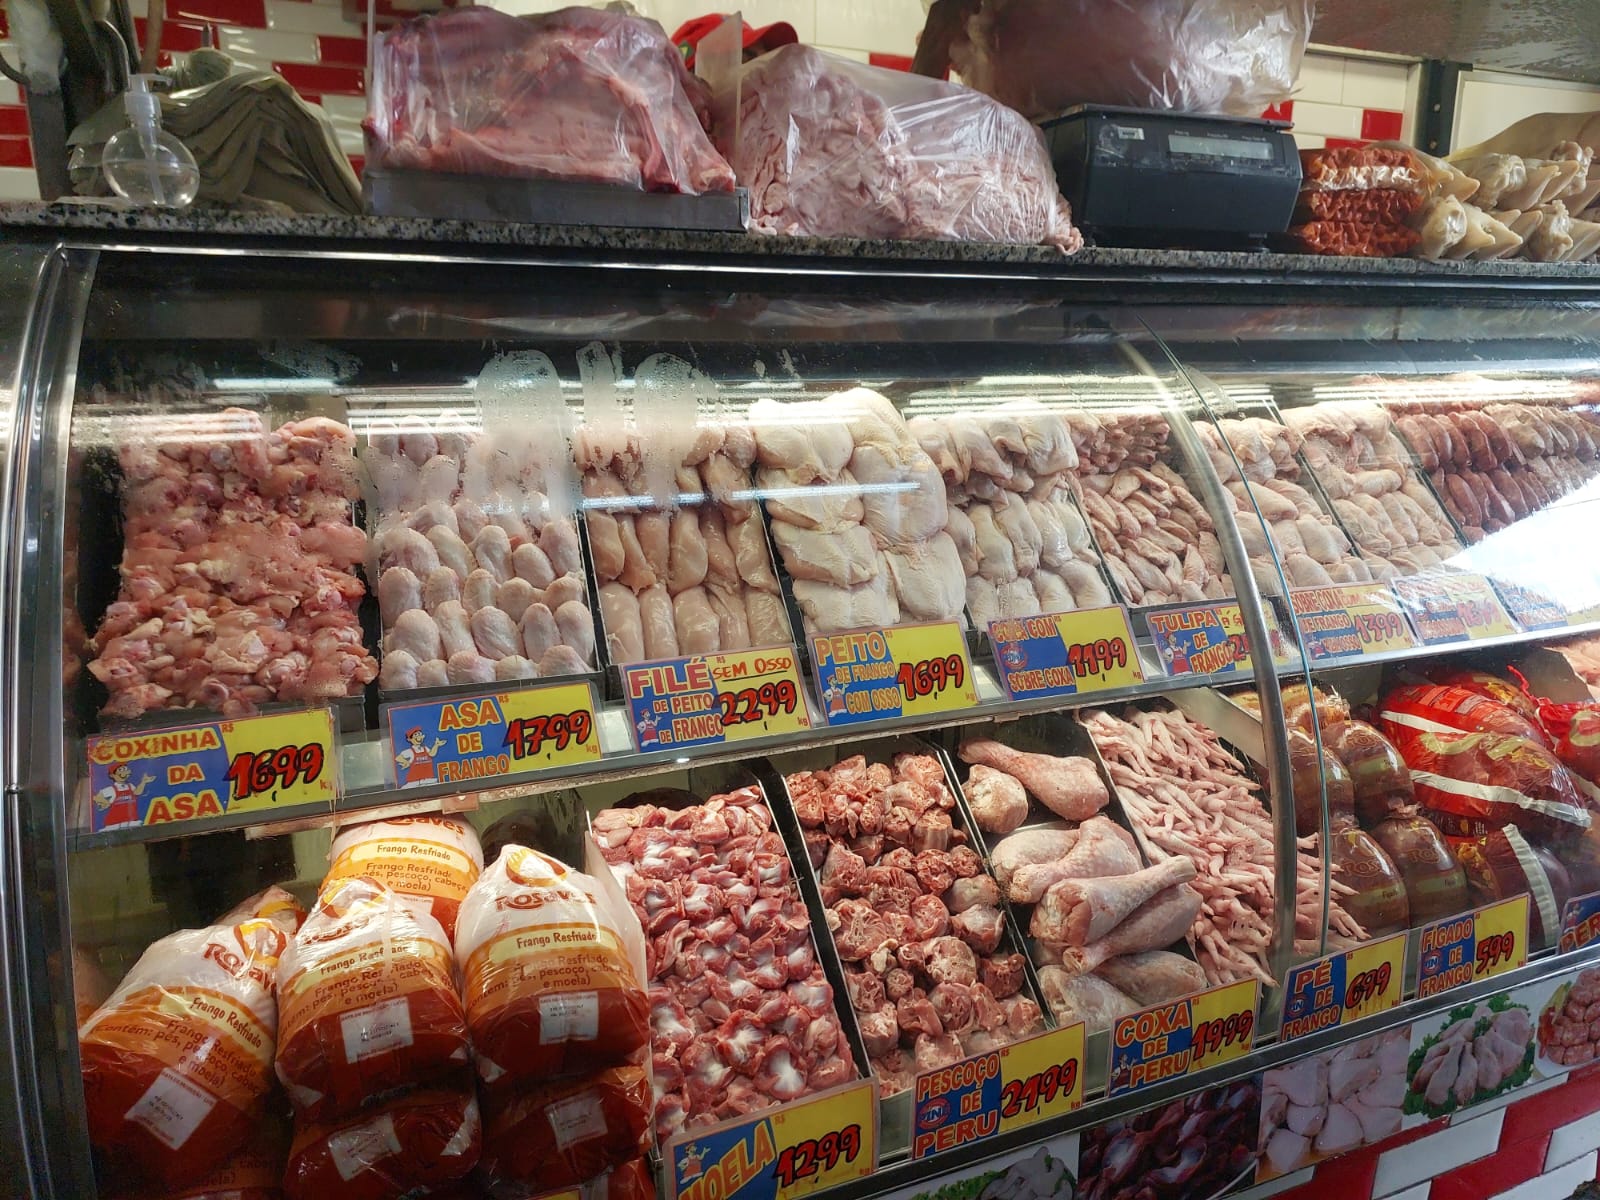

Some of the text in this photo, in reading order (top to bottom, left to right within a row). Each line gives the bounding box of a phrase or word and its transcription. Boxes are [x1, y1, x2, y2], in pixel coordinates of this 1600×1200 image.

[1318, 588, 1343, 611] COXA
[992, 616, 1057, 643] COA COM
[1151, 610, 1217, 633] TULIPA
[1315, 613, 1351, 630] FRANGO
[814, 632, 886, 666] PEITO
[1193, 631, 1209, 650] DE
[713, 657, 791, 680] SEM OSSO
[1190, 640, 1234, 673] FRANGO
[627, 657, 713, 698] FILÉ
[834, 660, 895, 684] DE FRANGO
[1007, 666, 1075, 692] SOBRE COXA
[653, 693, 714, 714] DE PEITO
[846, 686, 902, 715] COM OSSO
[439, 698, 500, 732] ASA
[222, 723, 234, 733] R$
[659, 713, 724, 744] DE FRANGO
[92, 728, 220, 763] COXINHA
[457, 732, 482, 755] DE
[586, 744, 598, 754] kg
[168, 764, 205, 785] DA
[437, 754, 510, 783] FRANGO
[144, 790, 225, 825] ASA
[377, 844, 451, 861] Frango Resfriado
[366, 862, 404, 873] Frango
[386, 871, 432, 883] pescoço,
[516, 935, 551, 949] Frango
[320, 956, 356, 976] Frango
[1448, 945, 1462, 967] DE
[539, 966, 588, 979] pescoço,
[543, 975, 591, 988] e moela)
[1294, 958, 1332, 994] PÉ
[1419, 962, 1473, 998] FRANGO
[314, 973, 359, 998] Frango
[345, 983, 399, 1006] e moela)
[1314, 985, 1335, 1009] DE
[191, 996, 263, 1049] Frango Resfriado
[1115, 1002, 1191, 1048] COXA
[1281, 1004, 1341, 1042] FRANGO
[153, 1030, 182, 1048] pés,
[167, 1020, 257, 1078] Frango Resfriado
[1142, 1036, 1169, 1059] DE
[179, 1054, 187, 1064] e
[187, 1060, 227, 1089] moela)
[917, 1053, 999, 1103] PESCOÇO
[1130, 1050, 1190, 1088] PERU
[960, 1089, 982, 1116] DE
[915, 1110, 998, 1159] PERU
[678, 1119, 776, 1200] MOELA
